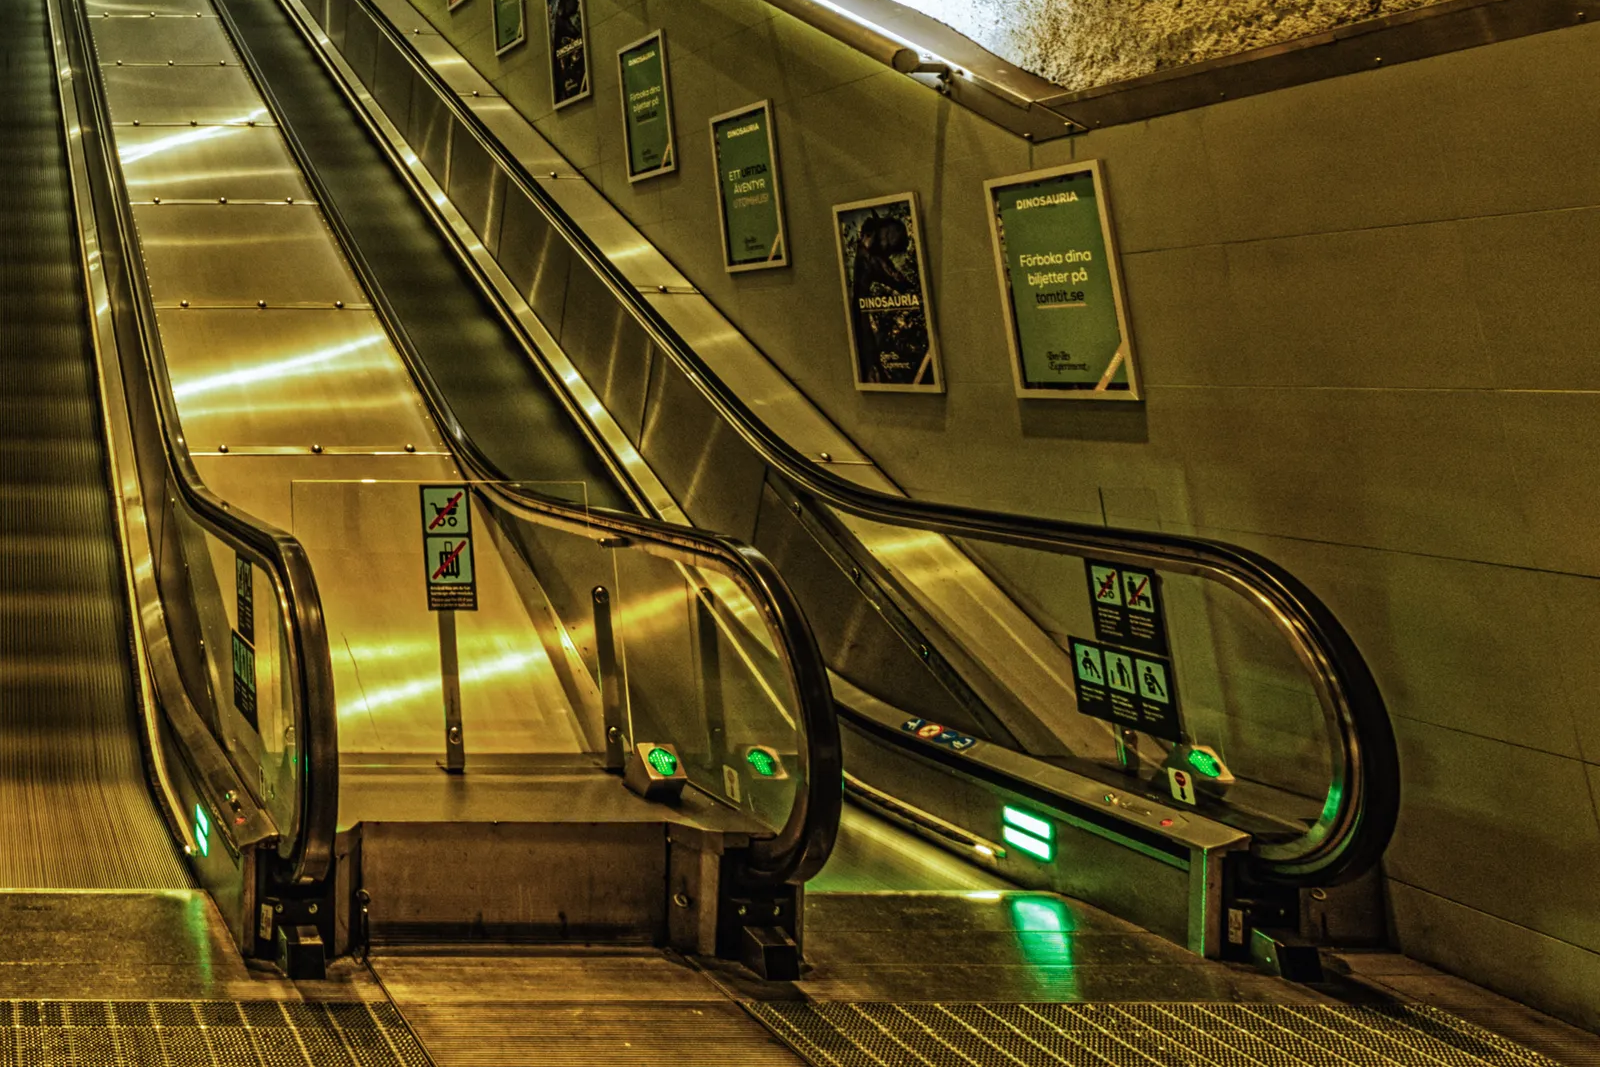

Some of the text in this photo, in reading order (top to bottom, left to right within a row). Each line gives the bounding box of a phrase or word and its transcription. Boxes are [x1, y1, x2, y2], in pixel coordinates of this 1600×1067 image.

[727, 122, 760, 139] DINOSAURIA
[728, 163, 768, 182] ETT URTIDA
[1016, 191, 1079, 210] DINOSAURIA
[1019, 248, 1092, 268] Förboka dina
[1027, 267, 1088, 289] biljetter på
[859, 294, 920, 310] DINOSAURIA
[1036, 288, 1085, 305] tomtit.se
